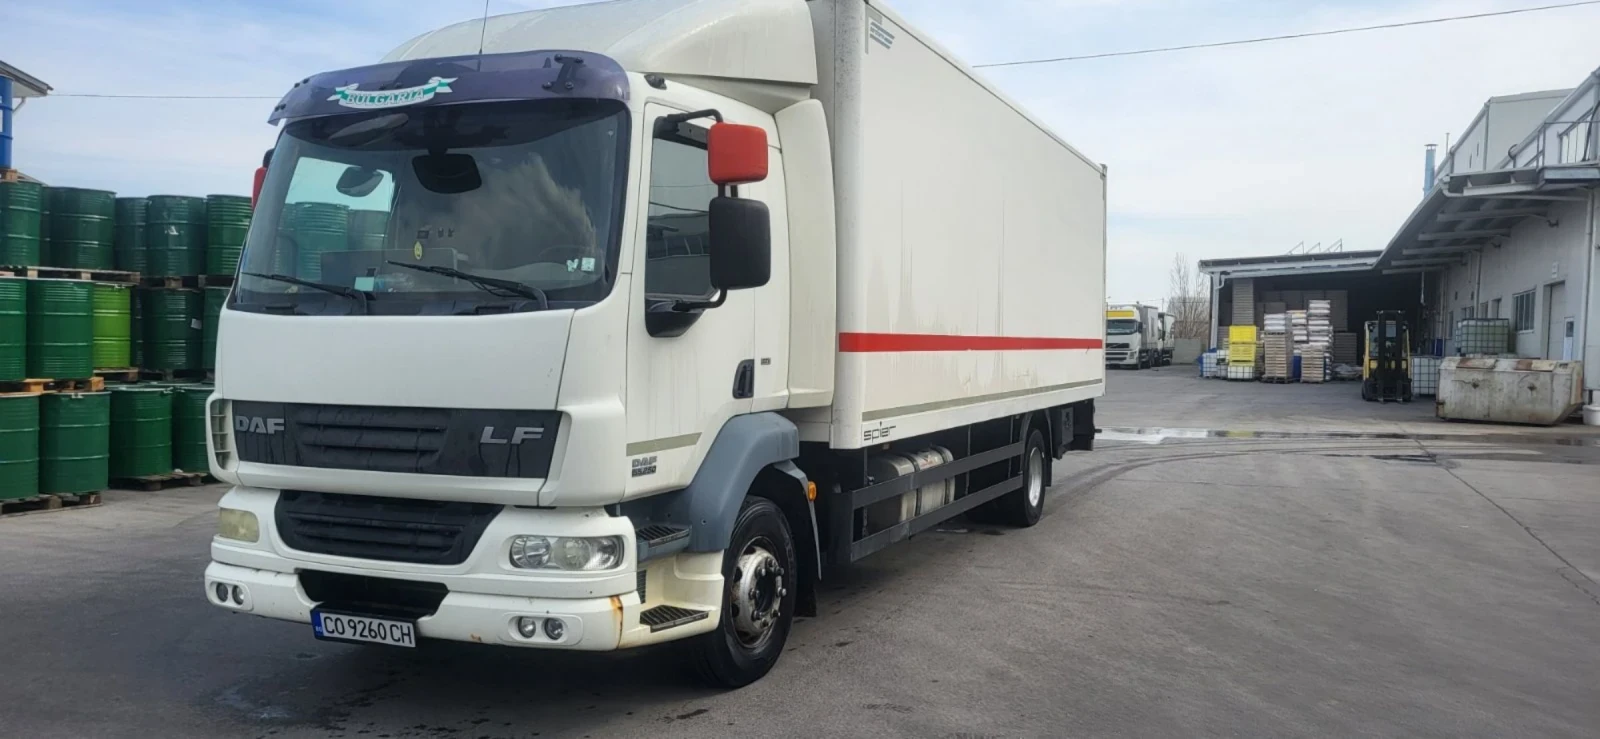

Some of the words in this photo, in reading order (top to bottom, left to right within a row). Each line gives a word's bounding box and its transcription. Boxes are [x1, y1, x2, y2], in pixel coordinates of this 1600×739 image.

[345, 87, 425, 106] BULGARIA
[234, 415, 285, 435] DAF
[480, 426, 544, 444] LF
[347, 619, 387, 641] 9260
[389, 624, 412, 644] CH
